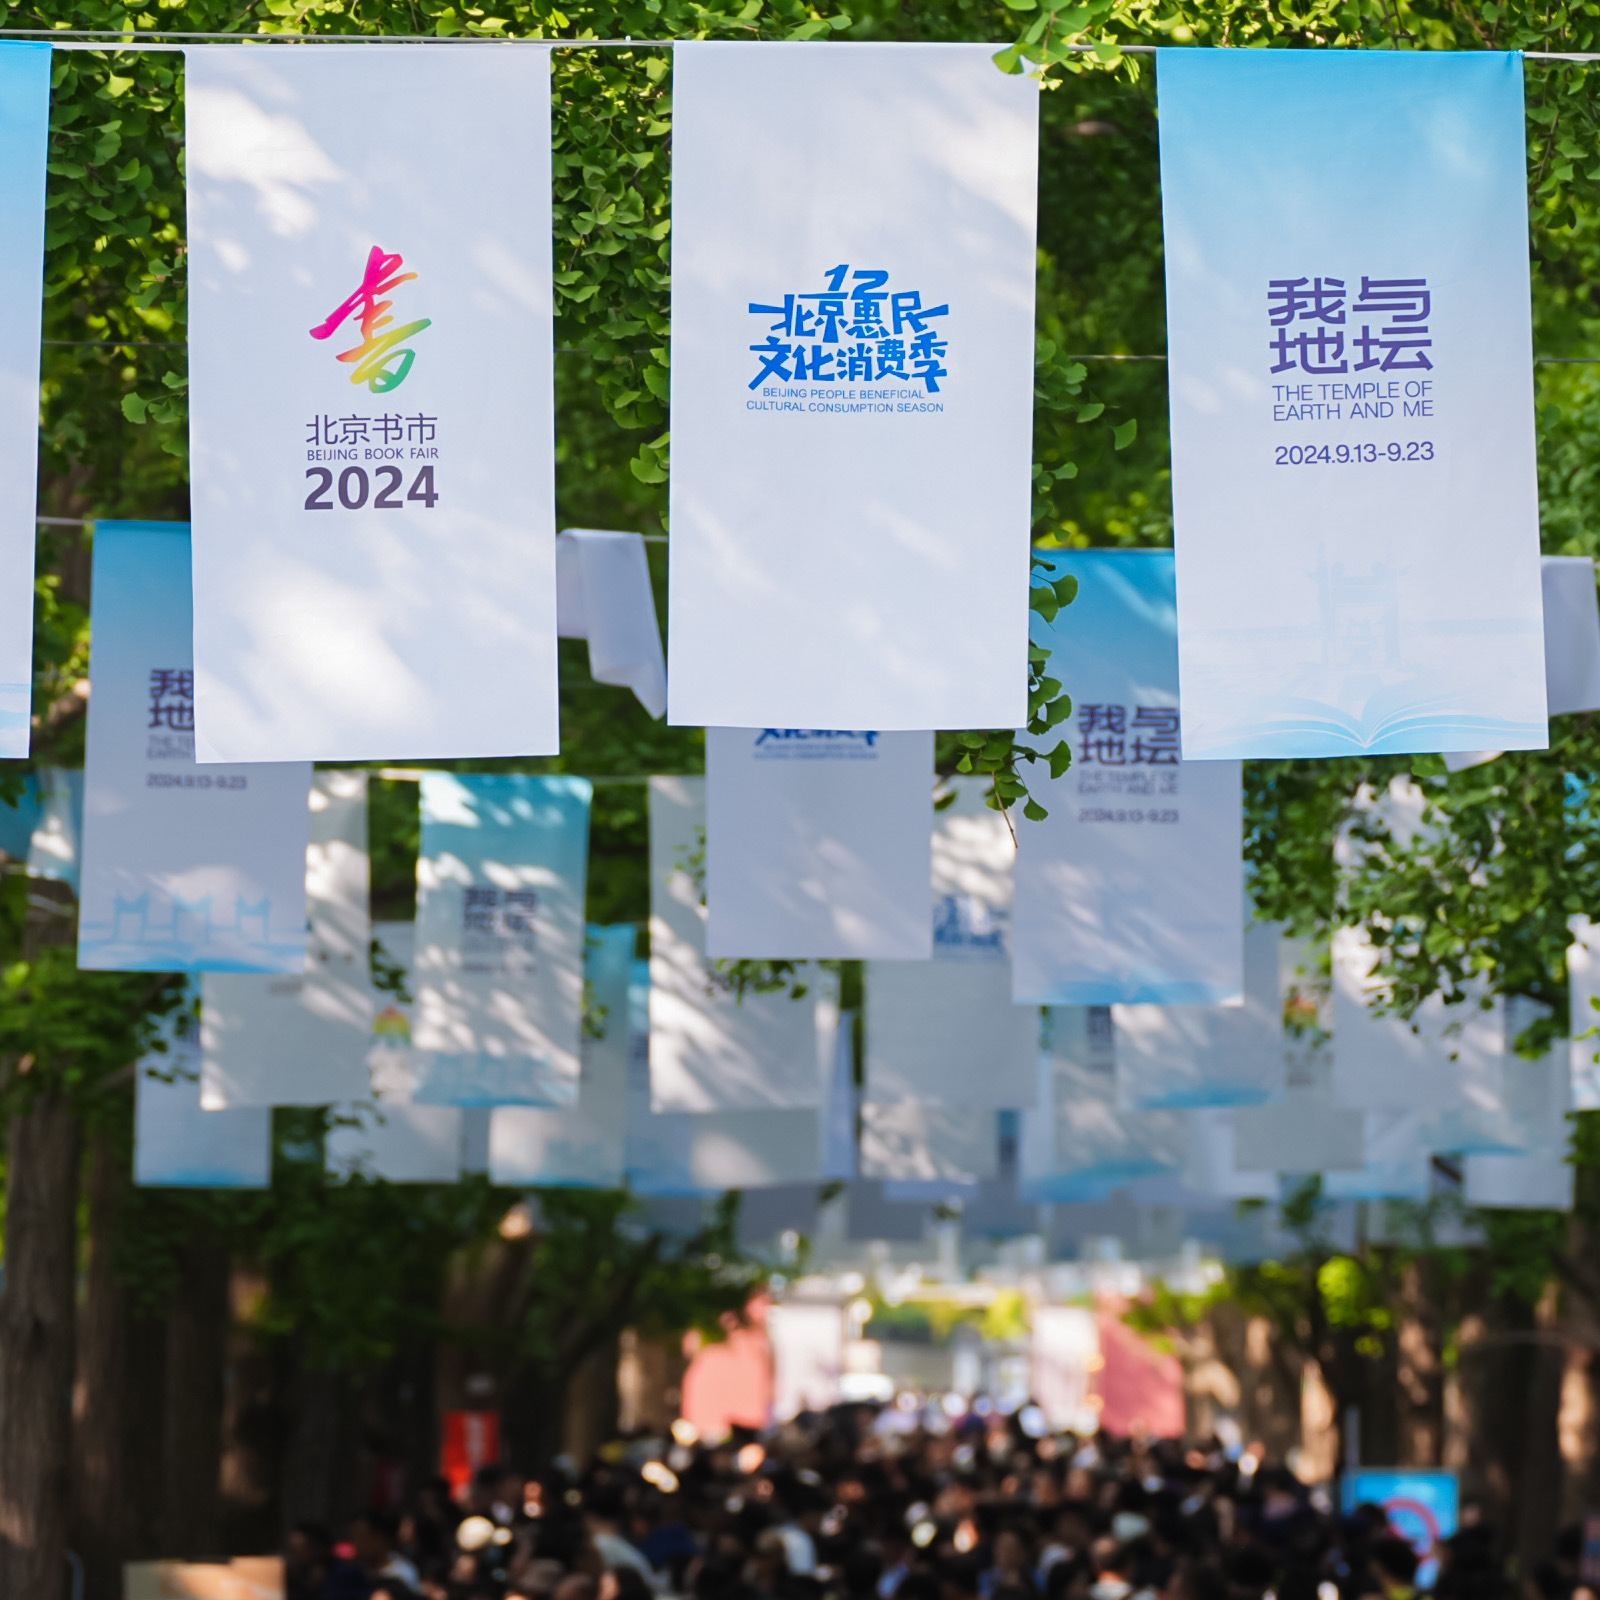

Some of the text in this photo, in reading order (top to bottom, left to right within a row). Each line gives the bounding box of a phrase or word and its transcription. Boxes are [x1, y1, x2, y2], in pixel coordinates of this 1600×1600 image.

[1267, 276, 1430, 326] 我与
[749, 291, 949, 343] 北京惠民
[748, 331, 948, 393] 文化消费季
[1269, 325, 1434, 374] 地坛
[763, 387, 925, 399] BEIJING PEOPLE BENEFICIAL
[1272, 380, 1433, 401] THE TEMPLE OF
[746, 400, 944, 413] CULTURAL CONSUMPTION SEASON
[1273, 400, 1434, 421] EARTH AND ME
[306, 413, 438, 445] 北京书市
[307, 447, 439, 461] BEIJING BOOK FAIR
[1275, 441, 1435, 465] 2024.9.13-9.23
[304, 466, 439, 510] 2024
[1078, 704, 1179, 735] 我与
[1078, 735, 1179, 766] 地坛
